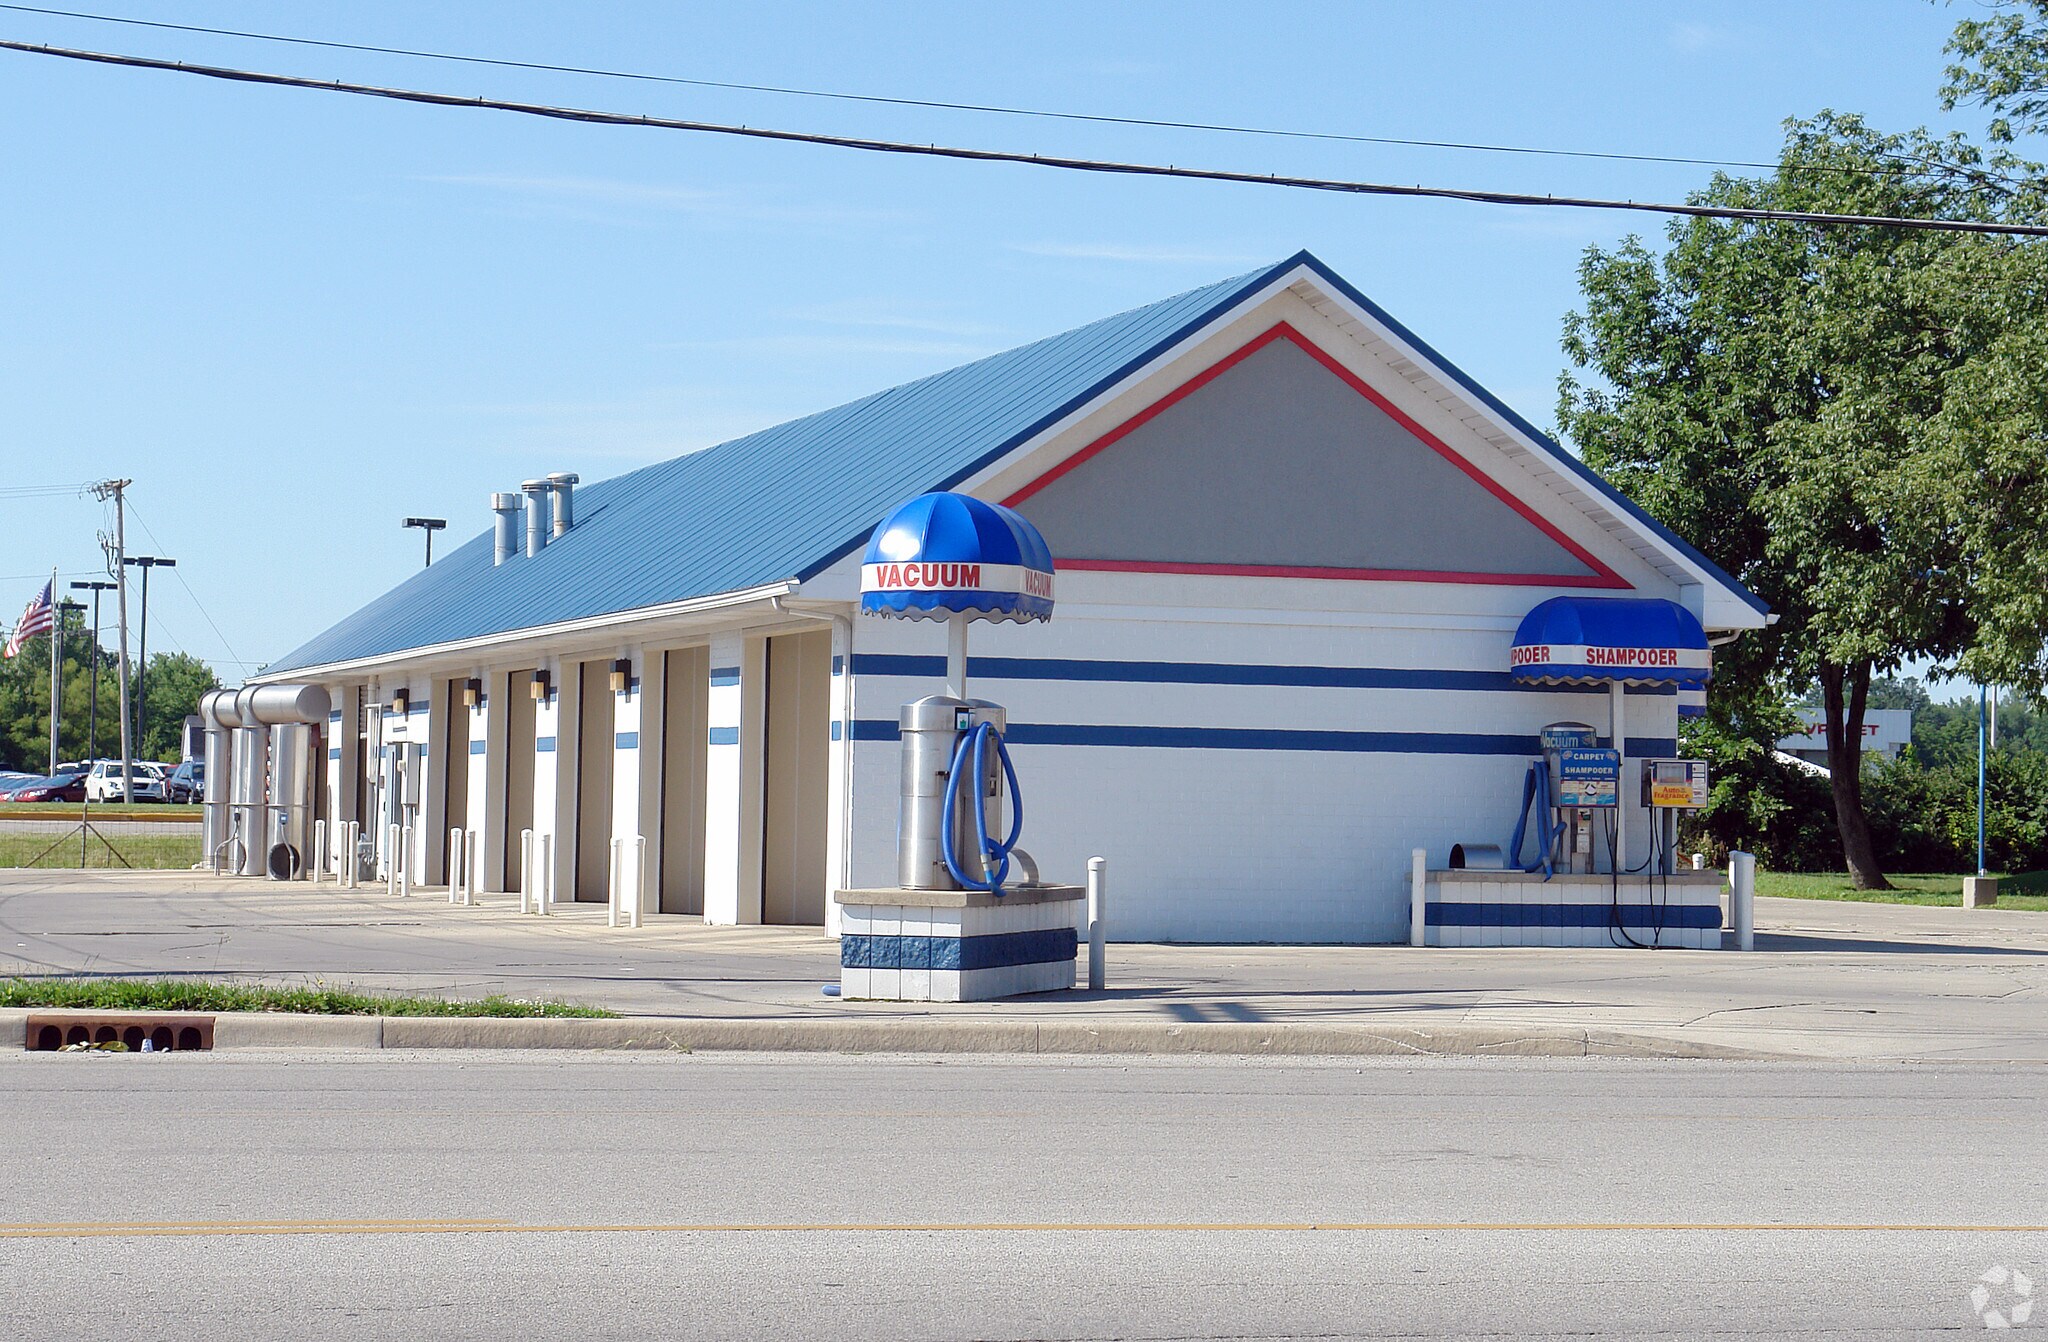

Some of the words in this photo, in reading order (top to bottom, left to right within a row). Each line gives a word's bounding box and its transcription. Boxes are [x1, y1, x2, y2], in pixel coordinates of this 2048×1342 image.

[876, 563, 981, 588] VACUUM
[1024, 569, 1052, 597] VACUUM
[1511, 646, 1550, 665] POOER
[1586, 648, 1677, 666] SHAMPOOER
[1565, 766, 1613, 774] SHAMPOOER
